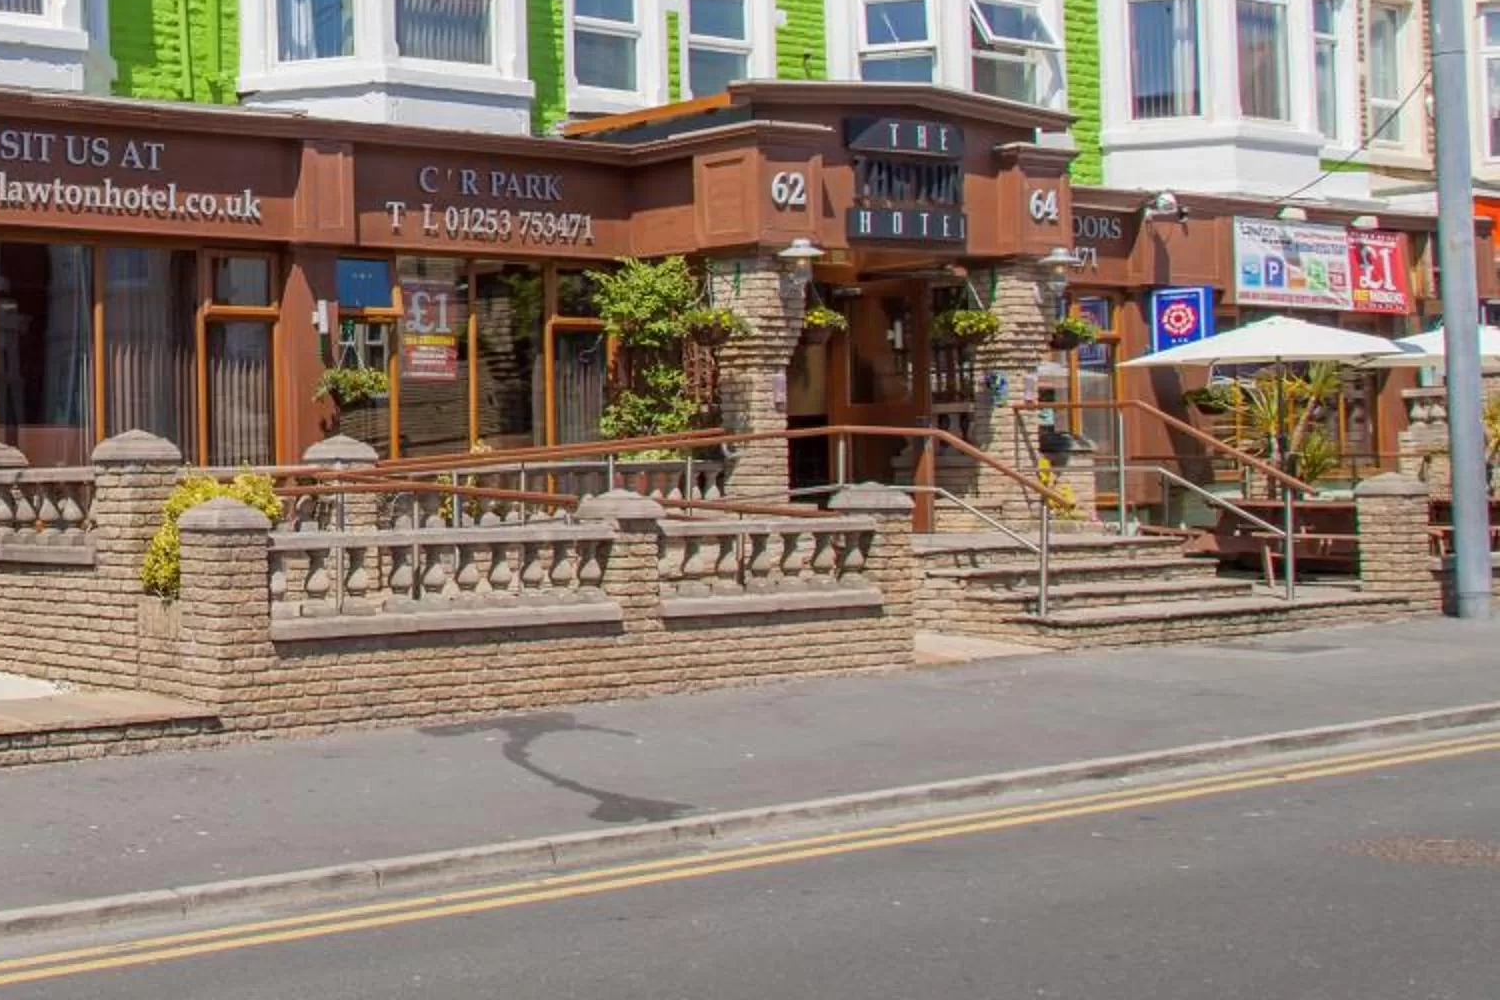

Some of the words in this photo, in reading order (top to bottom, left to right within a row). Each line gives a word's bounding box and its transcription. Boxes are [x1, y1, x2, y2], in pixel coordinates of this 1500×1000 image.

[63, 136, 111, 167] US
[119, 140, 165, 172] AT
[888, 123, 949, 151] THE
[490, 170, 563, 201] PARK
[771, 171, 806, 205] 62
[1029, 188, 1059, 221] 64
[445, 205, 512, 236] 01253
[518, 210, 595, 240] 753471
[405, 291, 453, 334] £1
